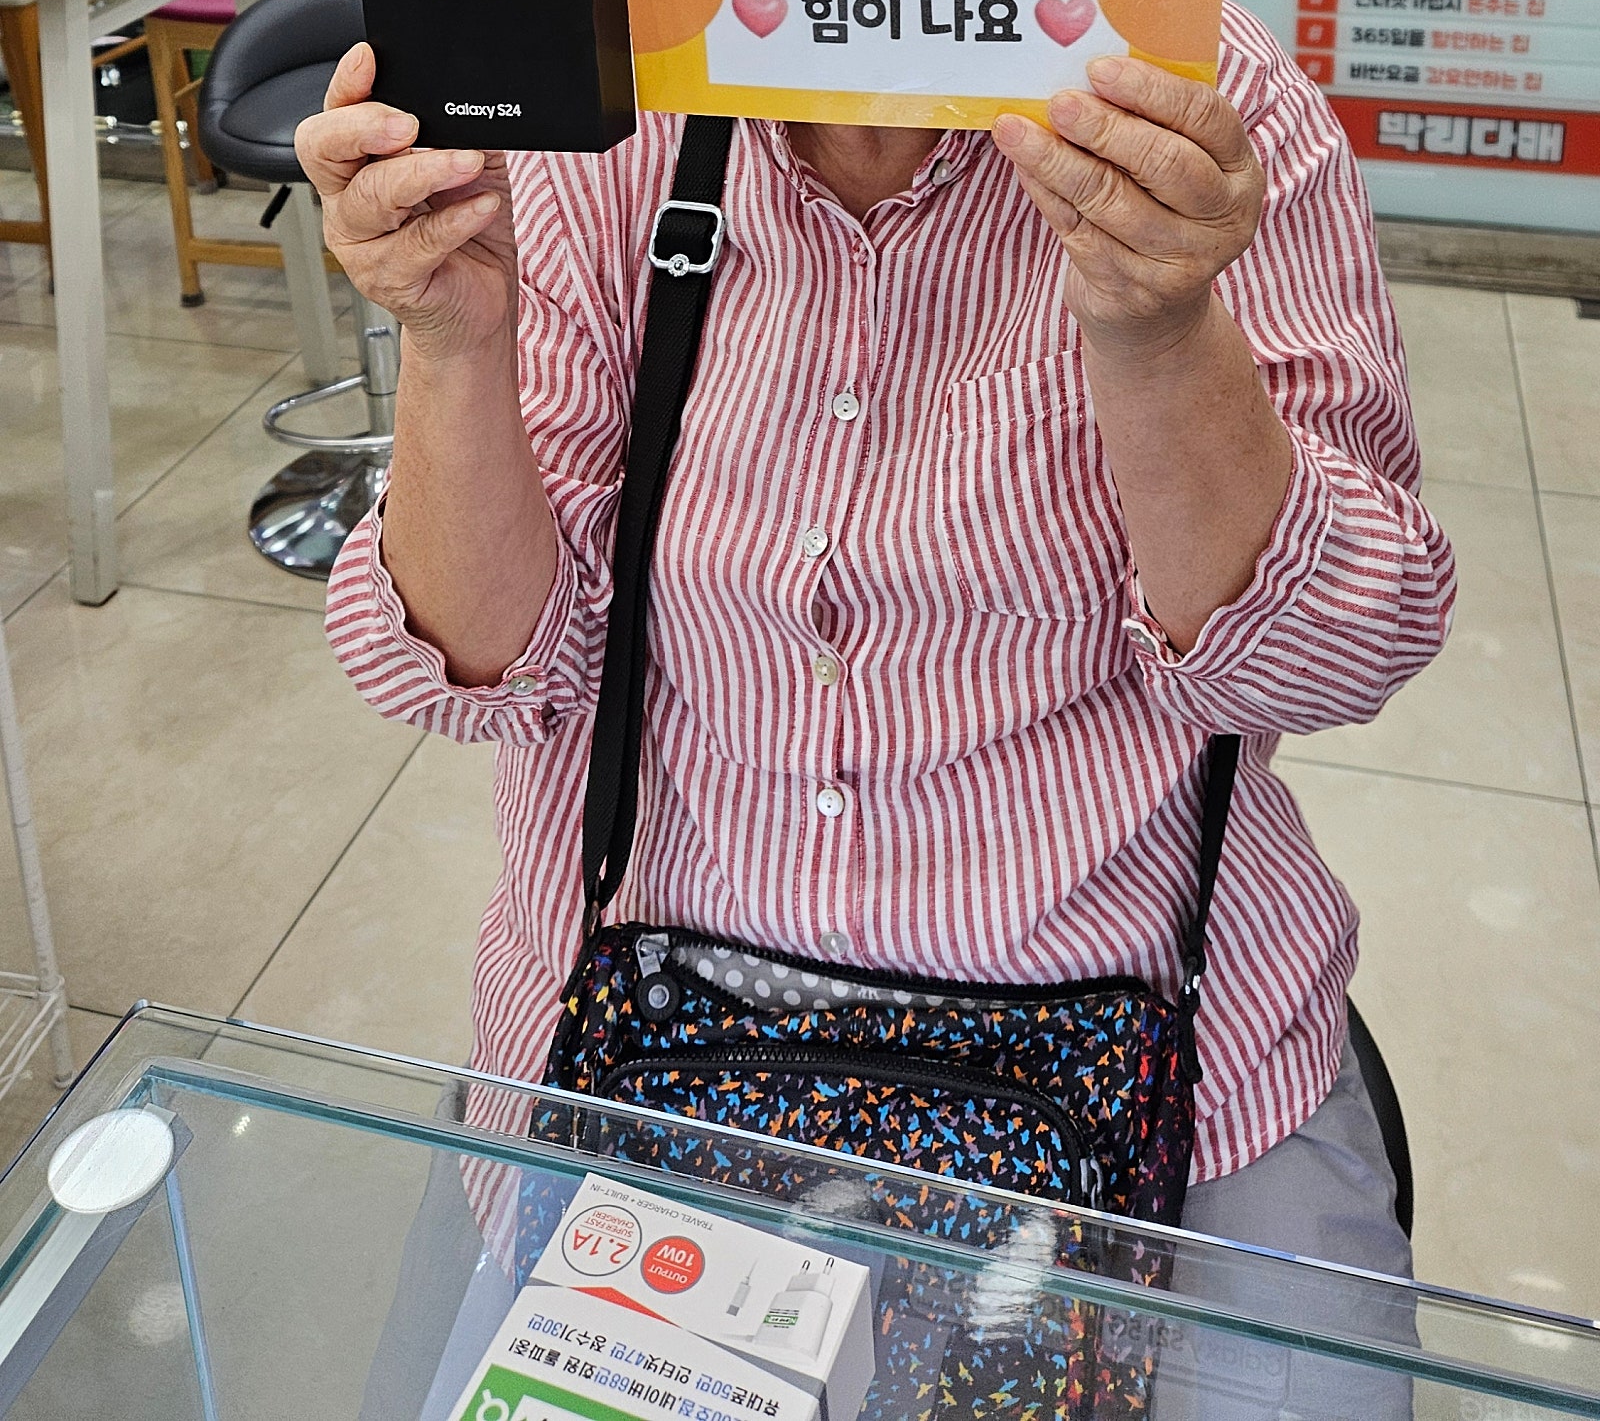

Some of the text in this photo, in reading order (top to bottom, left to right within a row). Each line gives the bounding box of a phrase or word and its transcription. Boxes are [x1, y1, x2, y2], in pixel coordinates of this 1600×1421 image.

[445, 102, 522, 119] Galaxy S24
[1376, 109, 1566, 163] 박리다매
[590, 1183, 629, 1201] BUILT-IN
[637, 1198, 680, 1218] CHARGER
[584, 1216, 634, 1238] SUPER FAST
[681, 1212, 714, 1231] TRAVEL
[572, 1229, 630, 1264] 2.1A
[656, 1245, 695, 1267] 10W
[648, 1265, 688, 1283] OUTPUT
[509, 1338, 561, 1367] 돌파중!
[528, 1313, 780, 1417] 휴대폰50만 인터넷47만 정수기30만
